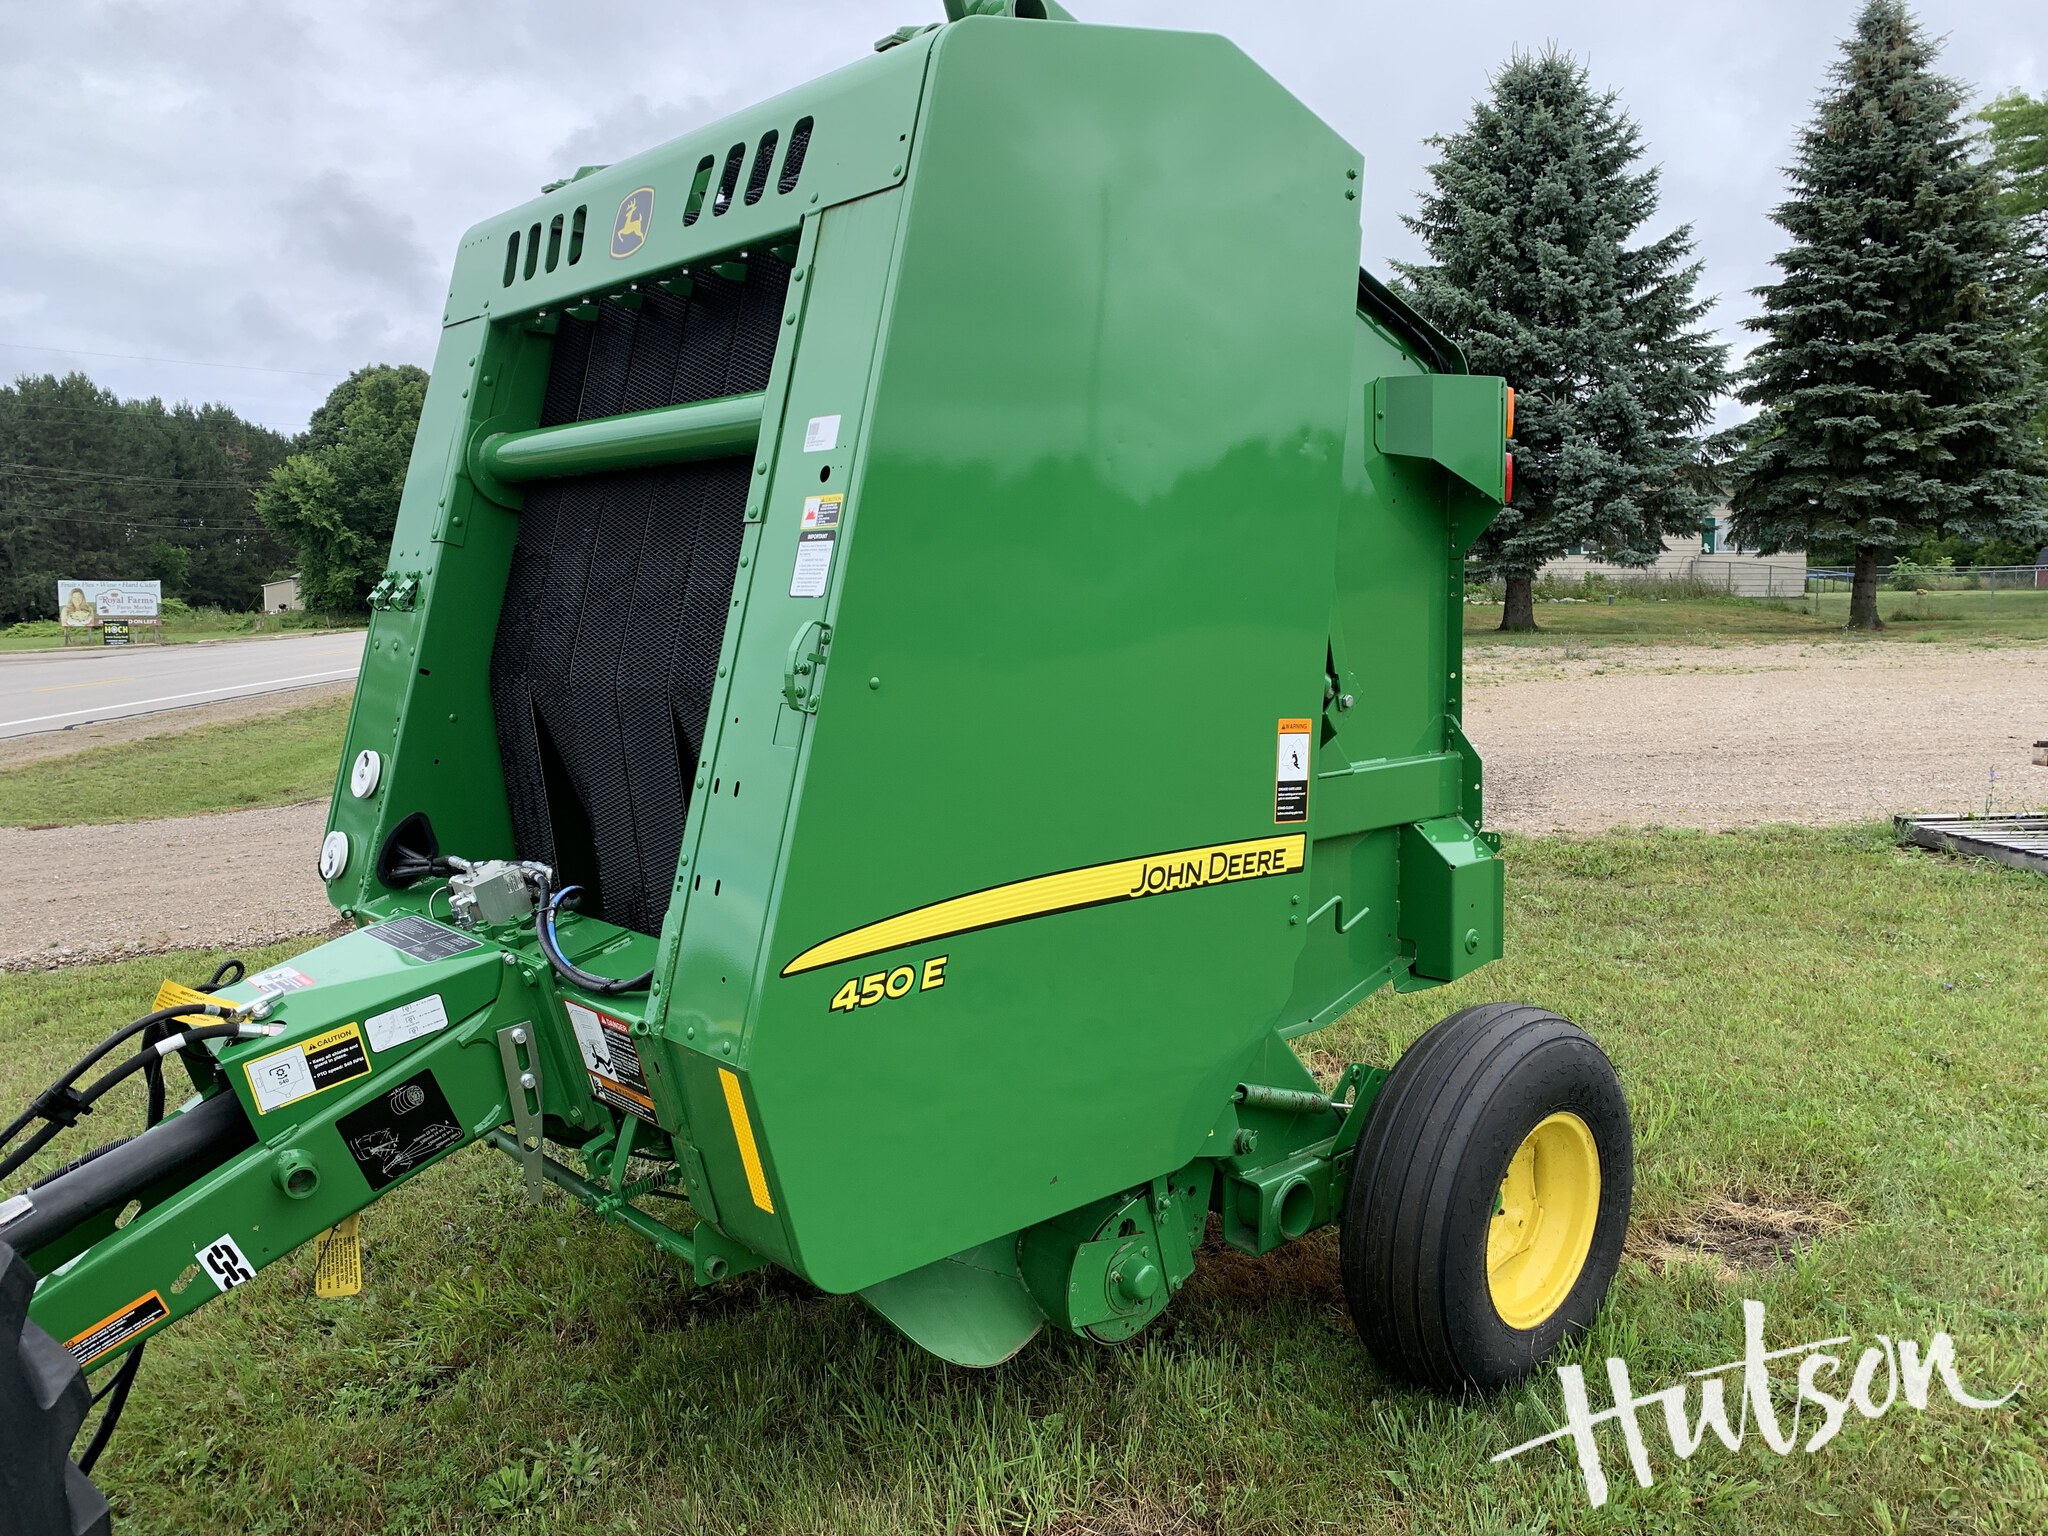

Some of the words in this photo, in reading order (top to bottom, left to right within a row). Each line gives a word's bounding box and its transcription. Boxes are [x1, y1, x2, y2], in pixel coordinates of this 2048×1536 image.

[99, 596, 124, 607] Royal
[128, 596, 154, 604] Farms
[1131, 859, 1203, 893] JOHN
[1208, 848, 1286, 880] DEERE
[829, 964, 916, 1013] 450
[919, 954, 949, 993] E
[605, 1018, 628, 1033] DANGER
[317, 1030, 352, 1047] CAUTION
[279, 1078, 289, 1086] 540
[1568, 1081, 1627, 1202] GOODYEAR
